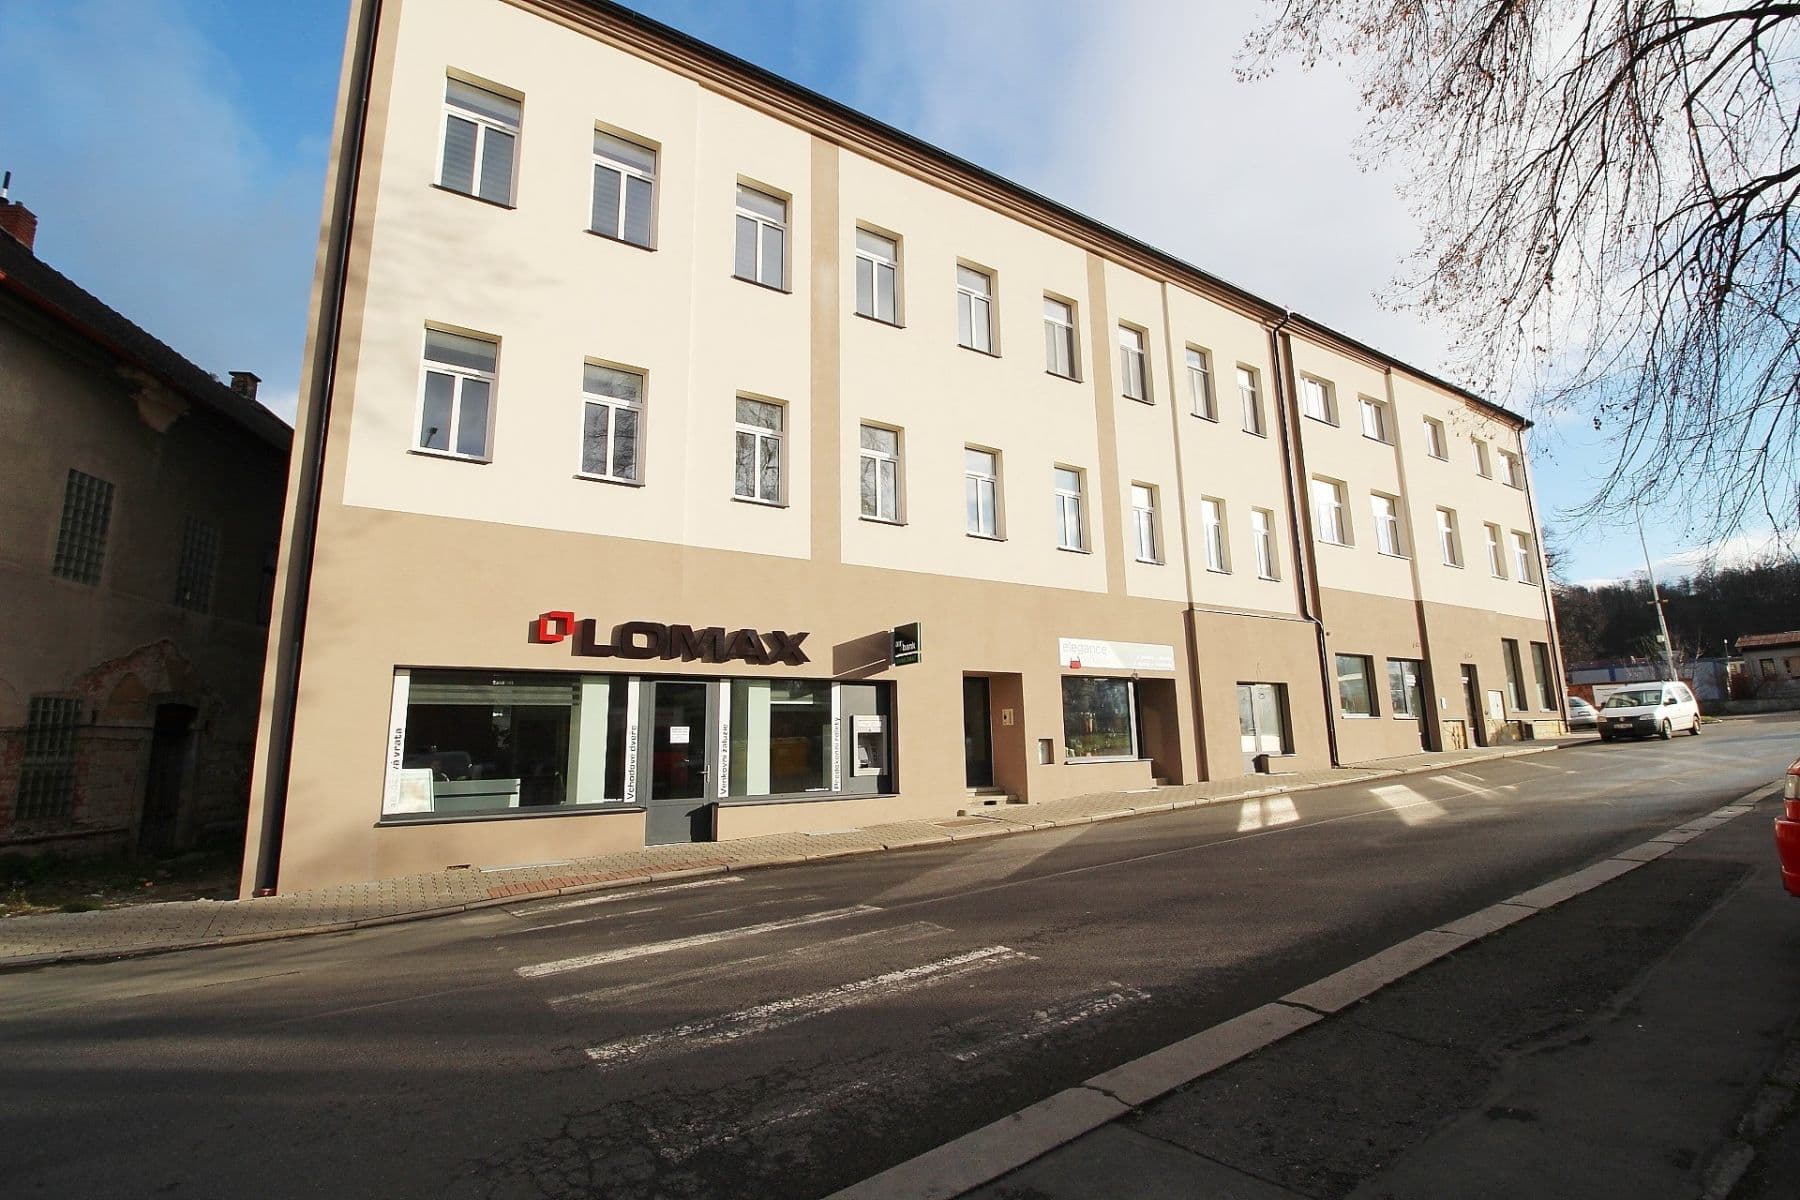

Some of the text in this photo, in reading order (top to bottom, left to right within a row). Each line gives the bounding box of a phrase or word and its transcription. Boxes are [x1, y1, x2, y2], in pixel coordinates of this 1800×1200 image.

[573, 619, 810, 665] LOMAX
[1062, 641, 1108, 656] elegance
[392, 727, 402, 758] vrata
